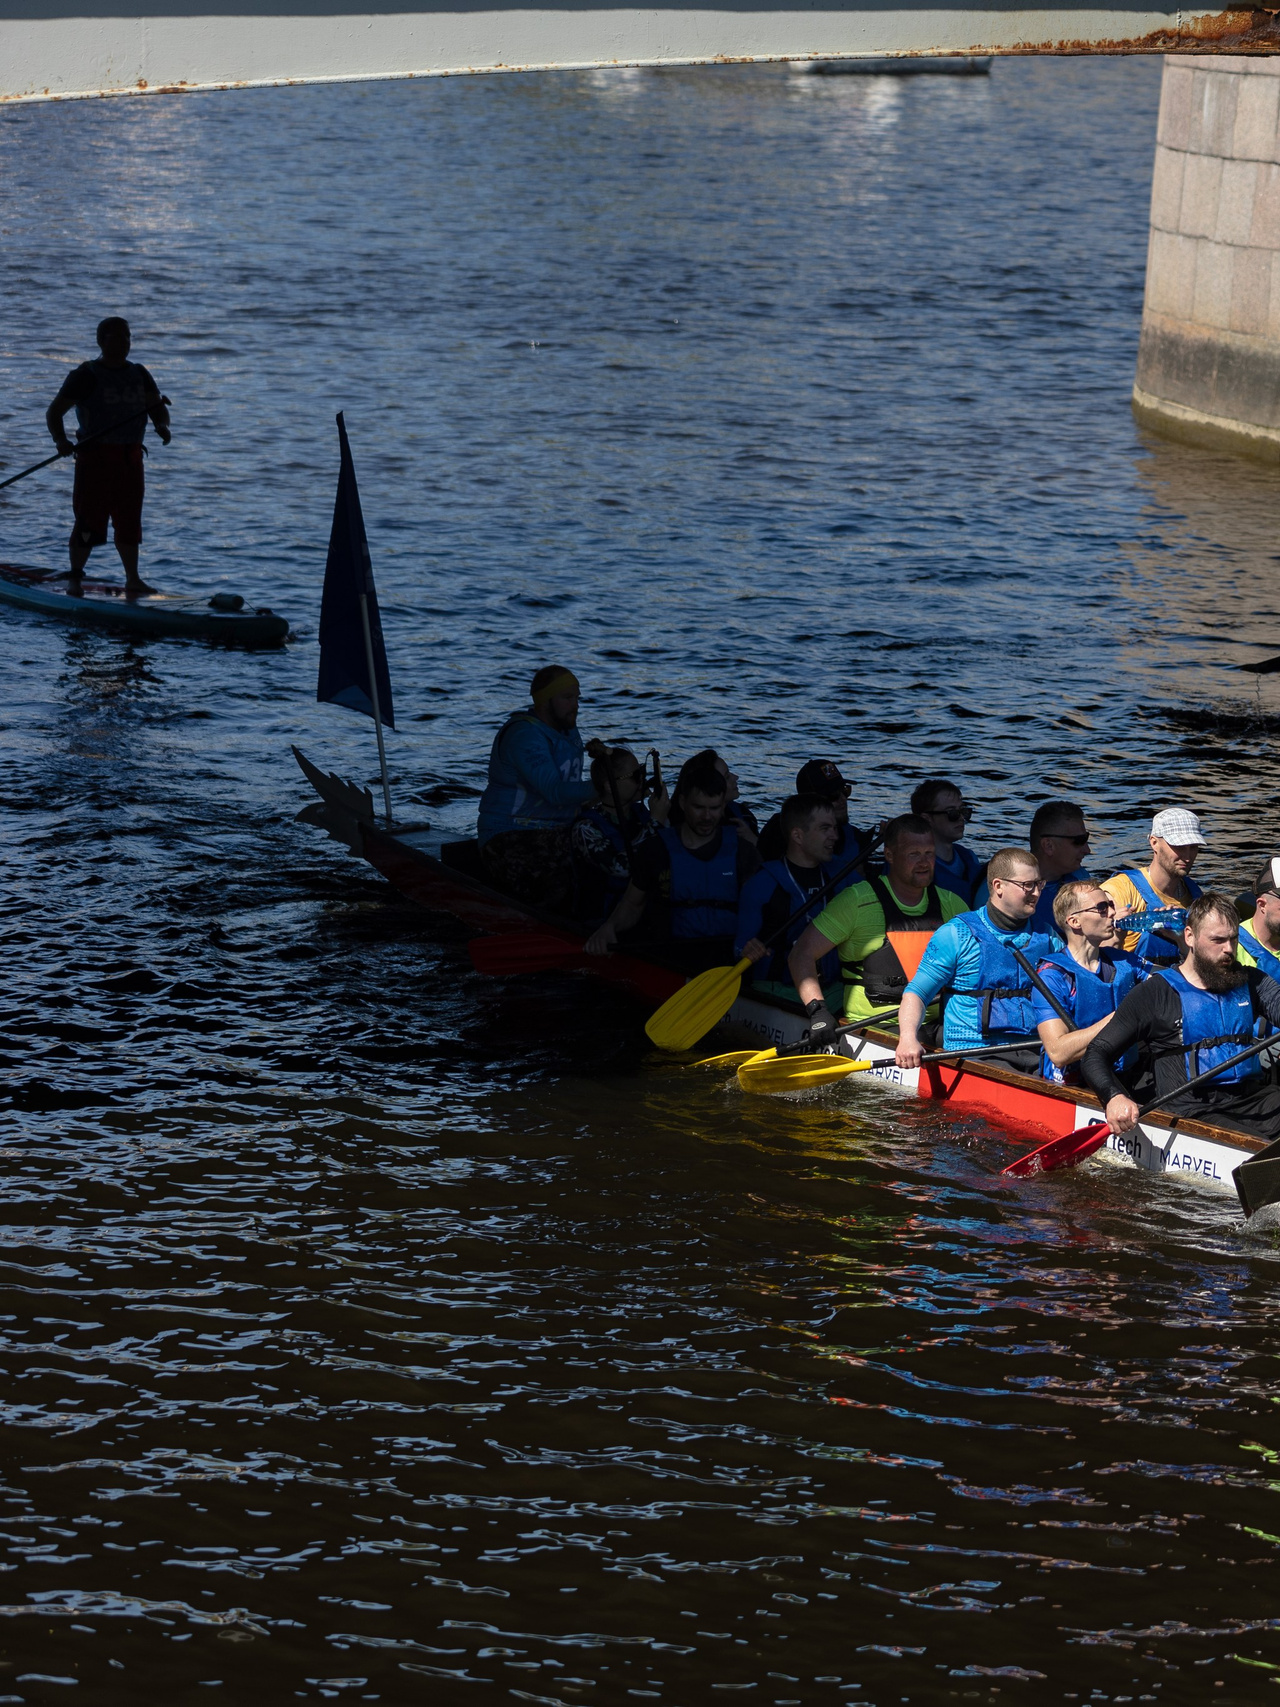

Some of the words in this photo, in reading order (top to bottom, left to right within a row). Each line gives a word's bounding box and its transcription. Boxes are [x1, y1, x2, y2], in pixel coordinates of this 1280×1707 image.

[743, 1018, 786, 1046] MARVEL
[860, 1060, 904, 1086] ARVEL
[1112, 1135, 1142, 1159] tech
[1159, 1147, 1222, 1180] MARVEL
